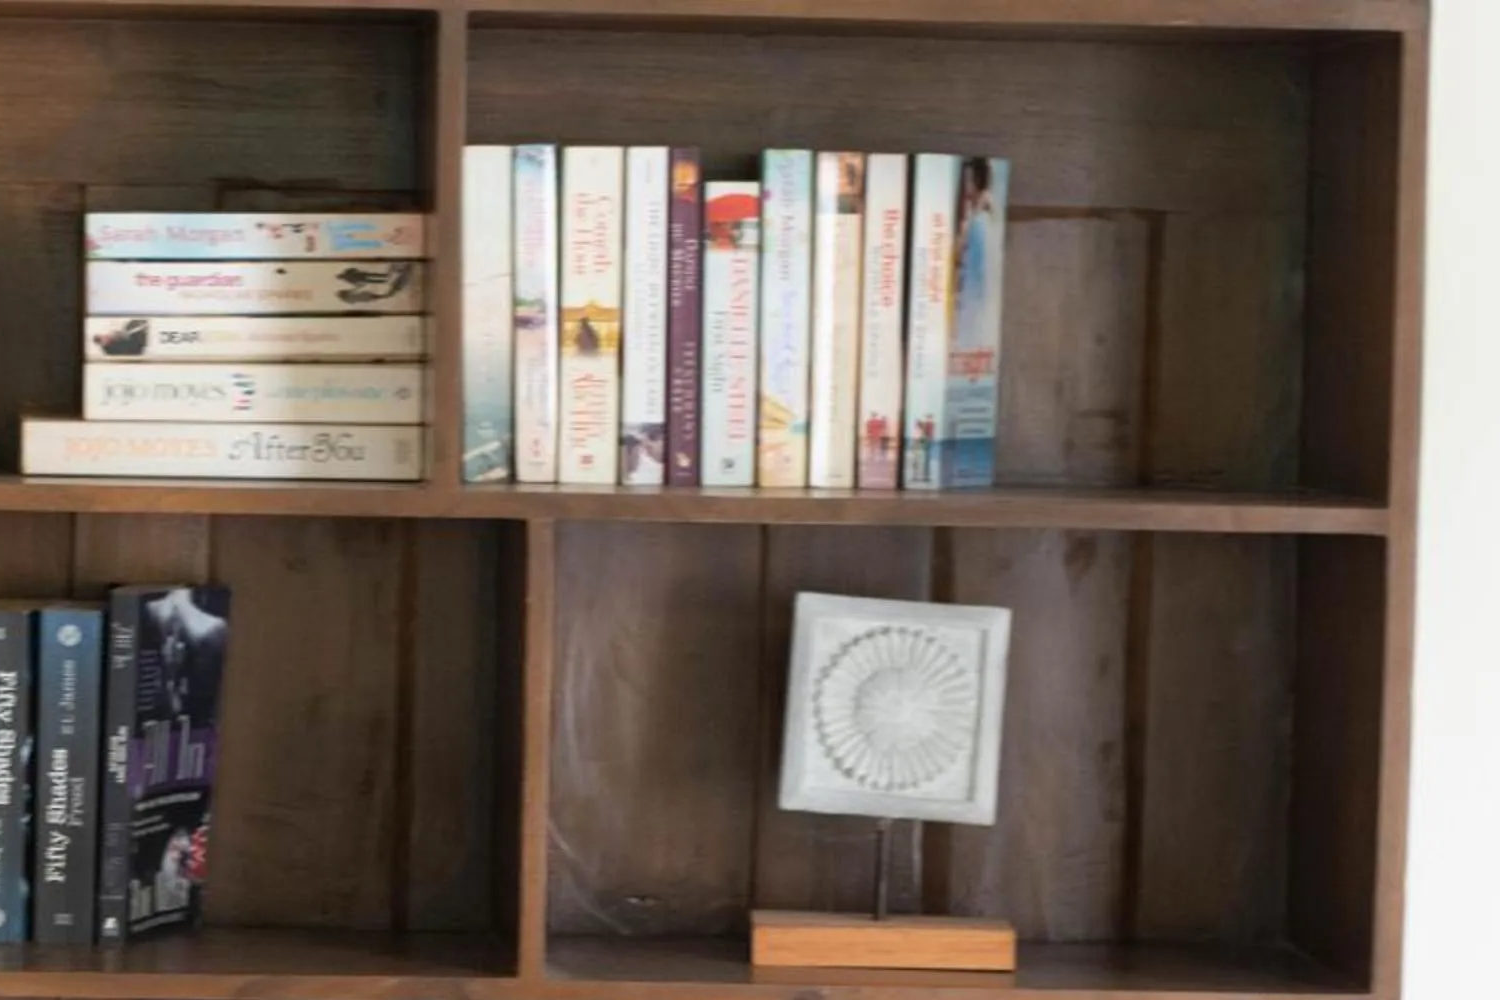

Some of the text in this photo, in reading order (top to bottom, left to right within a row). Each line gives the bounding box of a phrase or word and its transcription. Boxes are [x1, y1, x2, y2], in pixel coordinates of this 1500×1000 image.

[882, 208, 901, 240] the
[159, 331, 199, 344] DEAR
[44, 748, 69, 884] Fifty Shades
